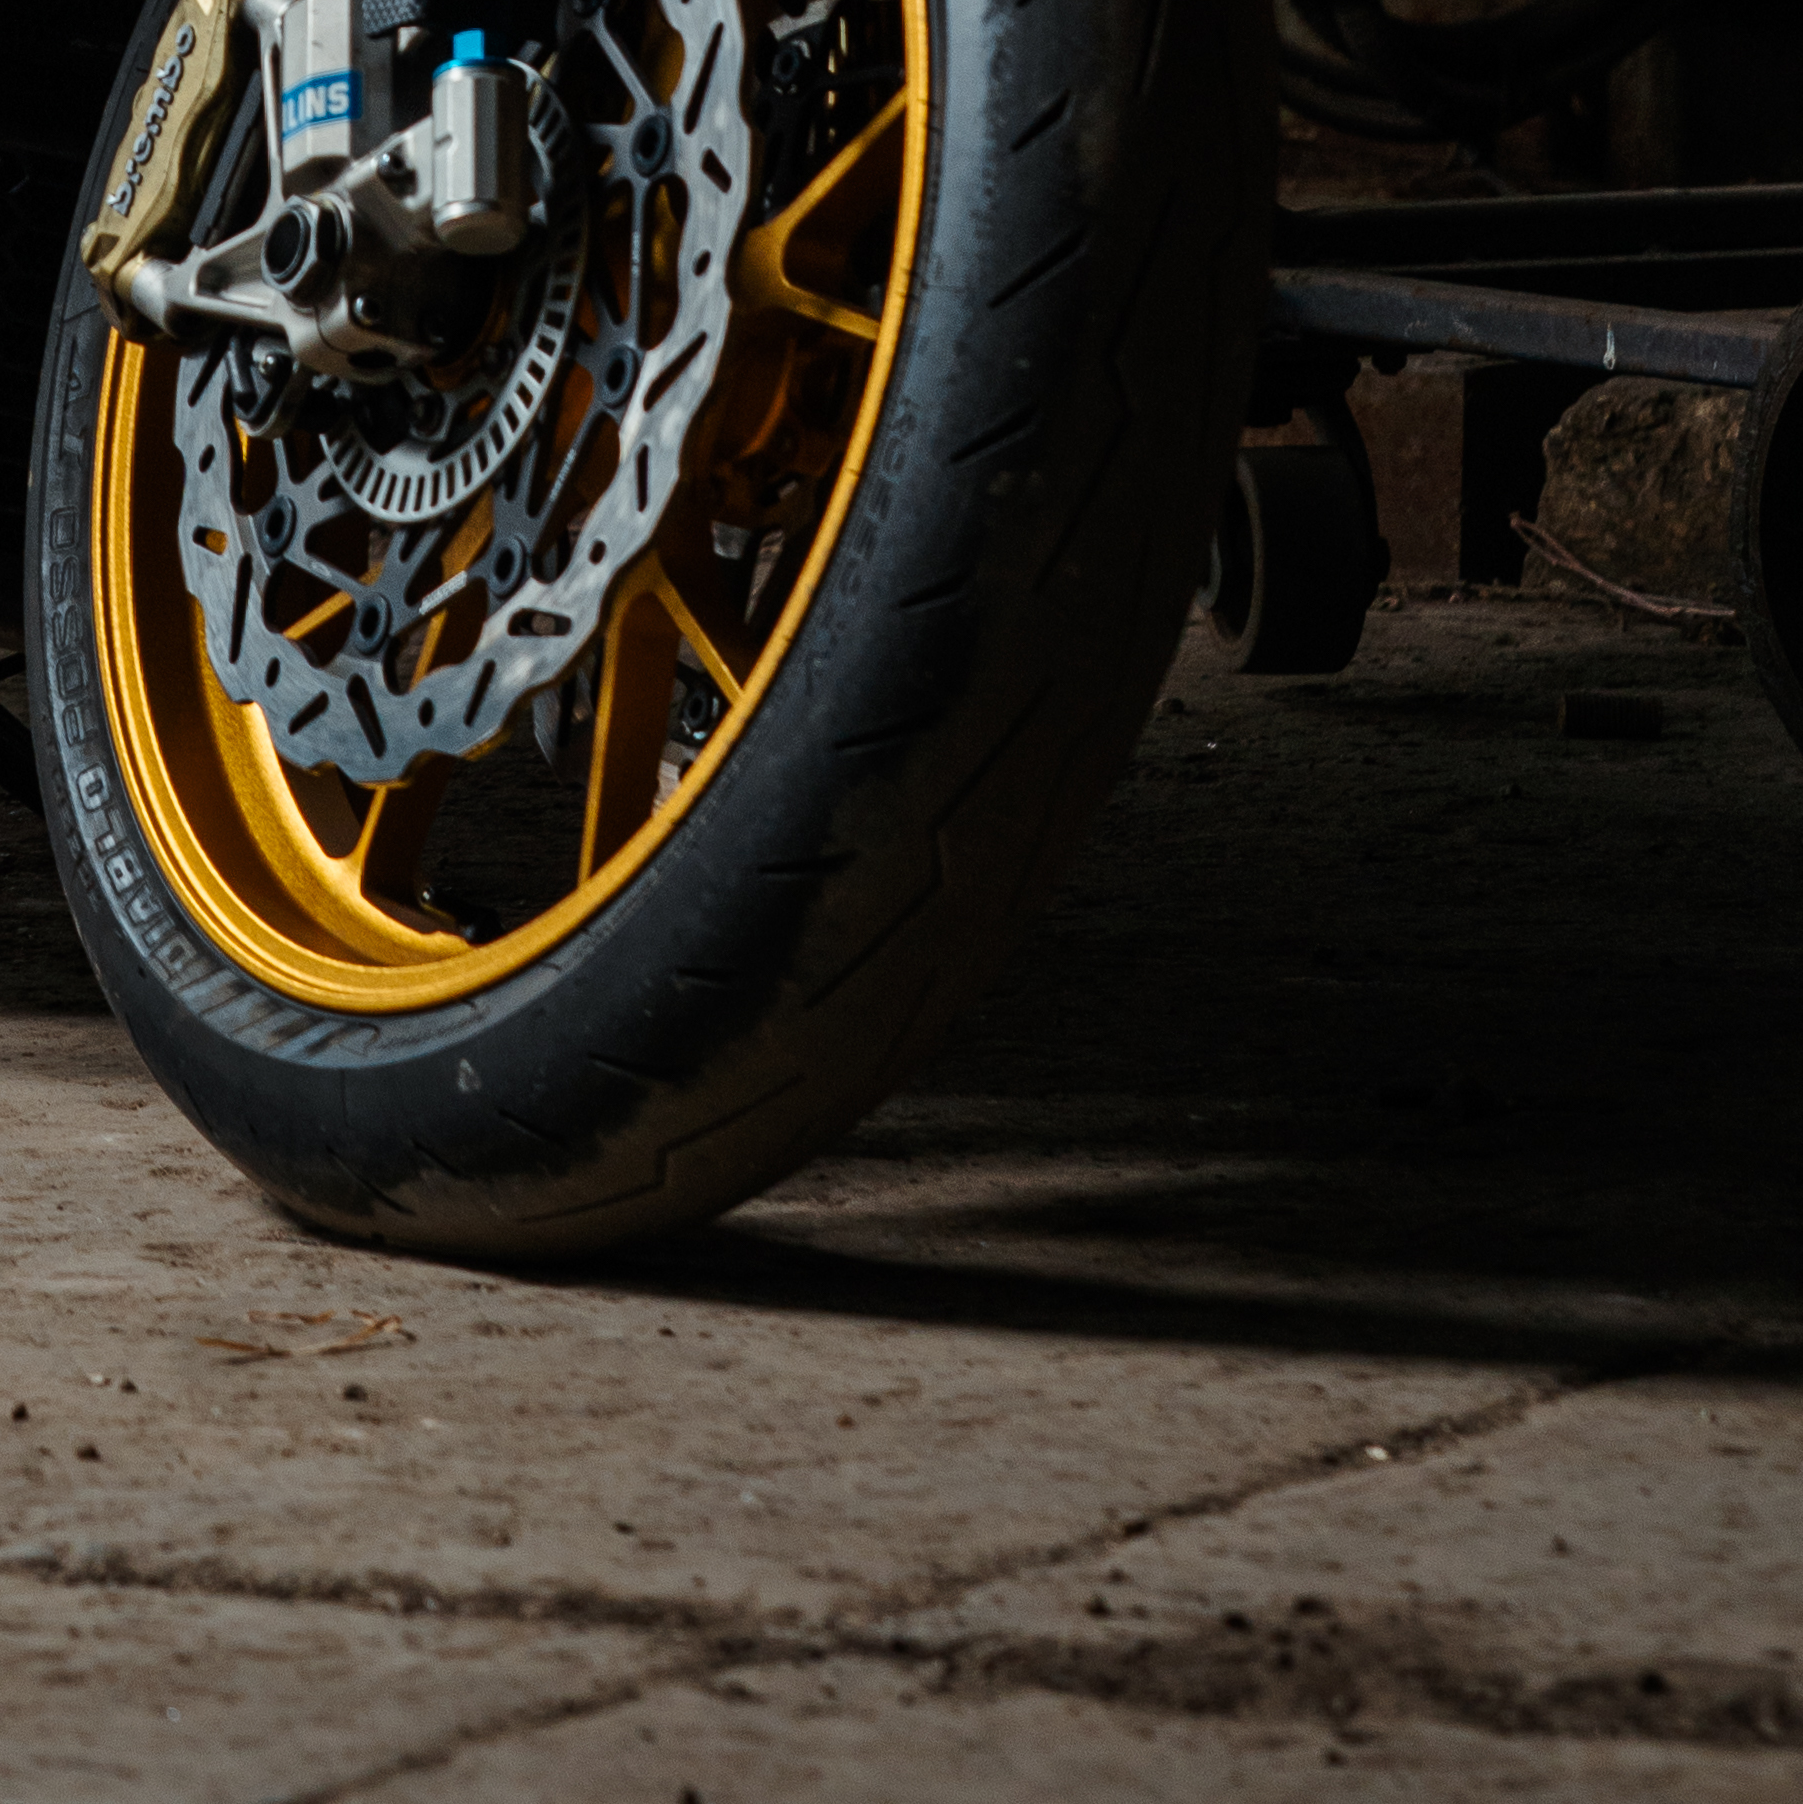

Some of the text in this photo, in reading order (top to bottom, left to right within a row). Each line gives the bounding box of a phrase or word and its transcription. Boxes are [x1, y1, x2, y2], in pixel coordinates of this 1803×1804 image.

[106, 23, 196, 218] brembo
[48, 503, 93, 751] ROSSO
[74, 763, 201, 991] DIABLO
